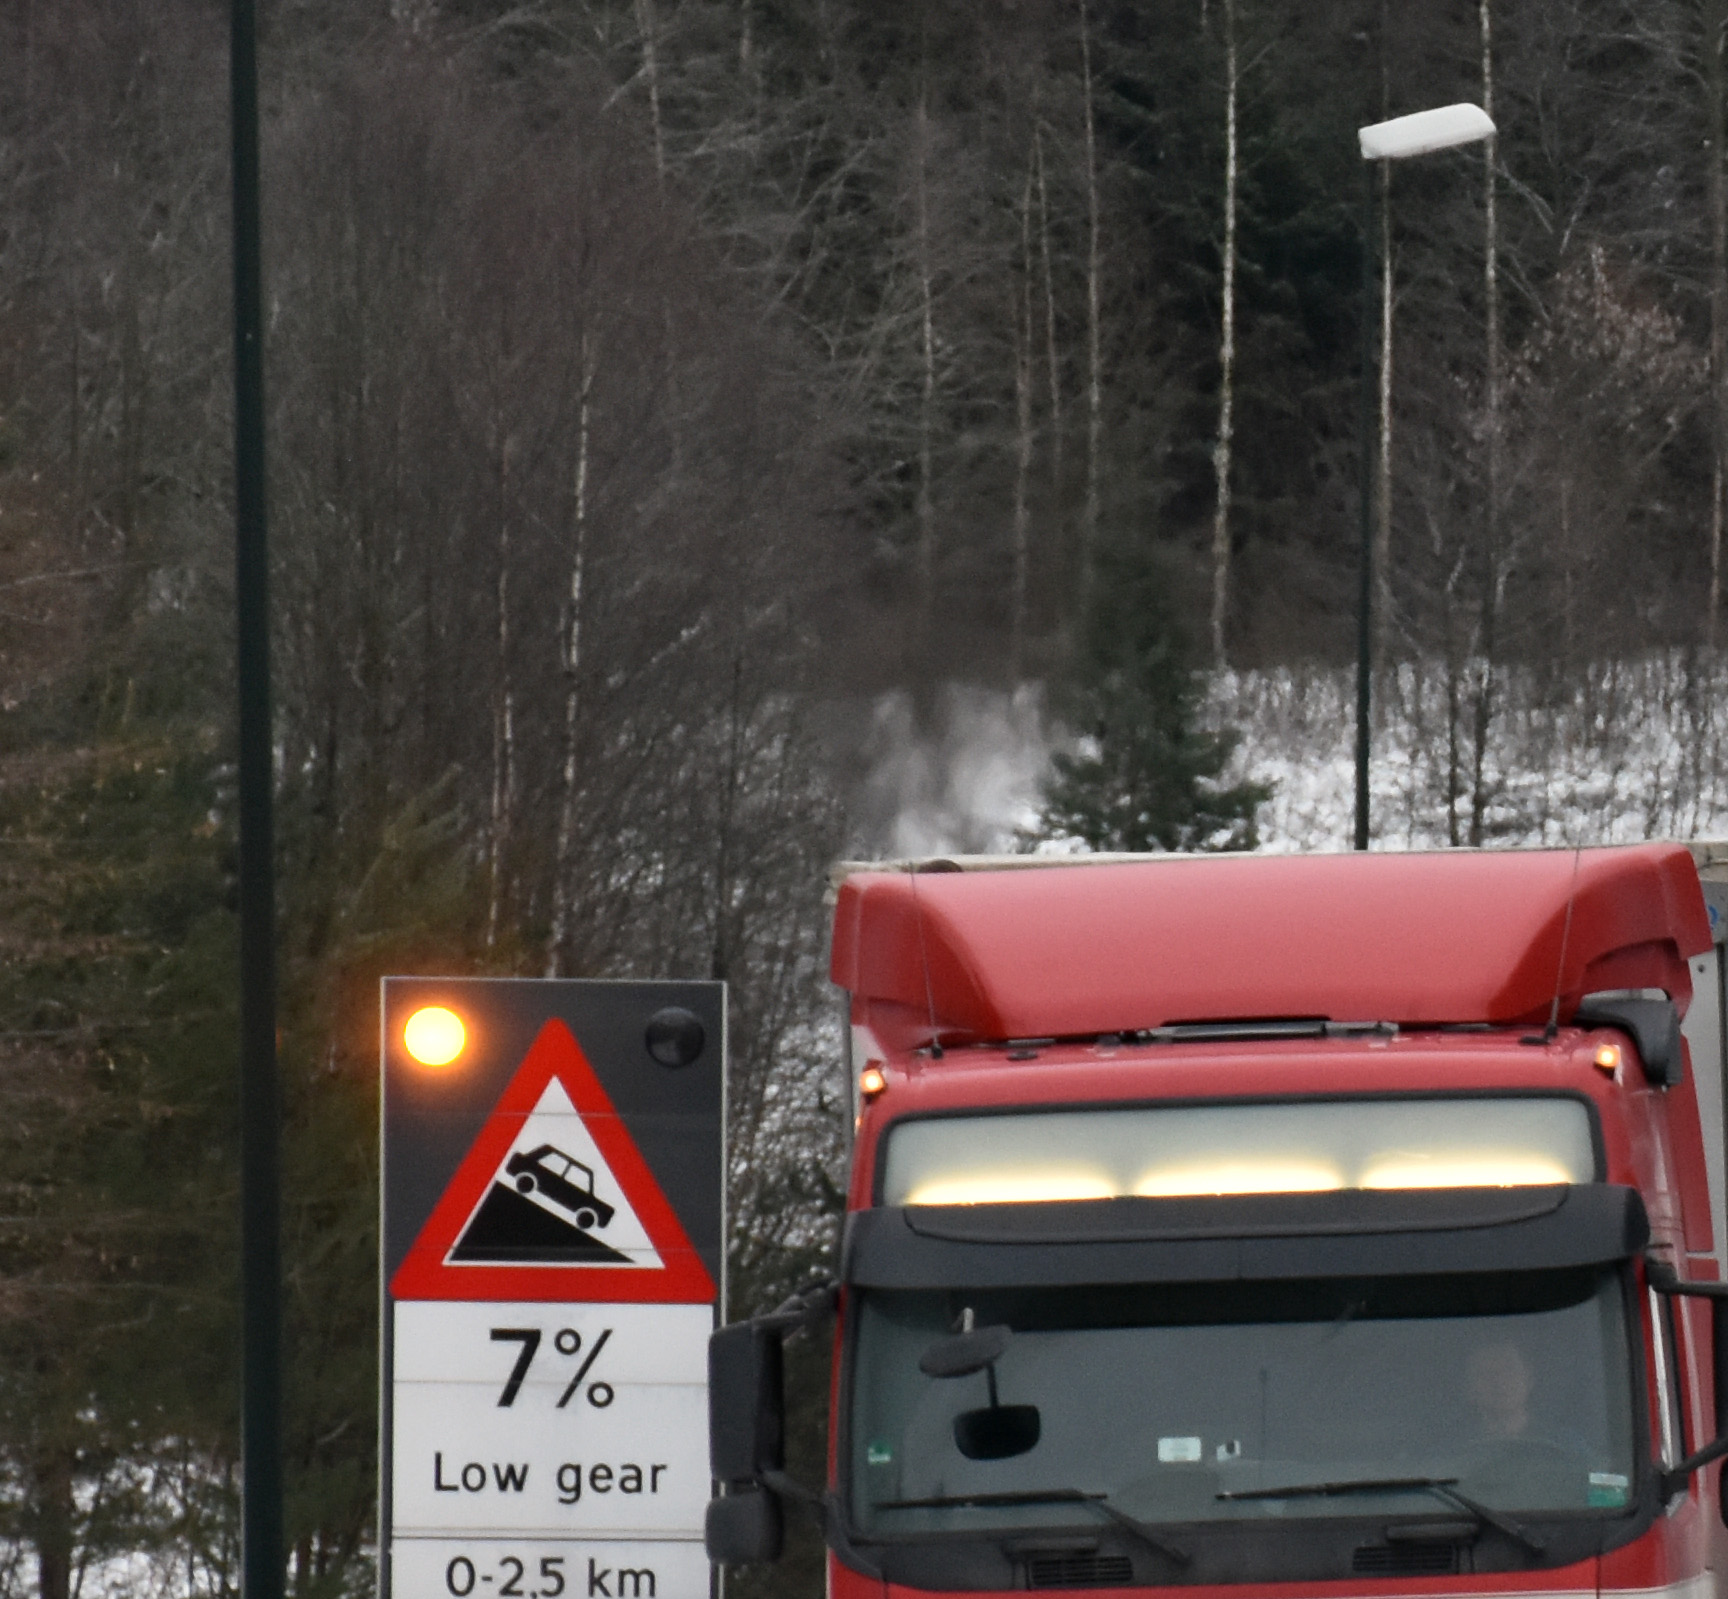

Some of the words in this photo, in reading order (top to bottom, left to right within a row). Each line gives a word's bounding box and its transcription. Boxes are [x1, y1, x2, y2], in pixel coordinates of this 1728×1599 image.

[489, 1327, 615, 1409] 7%
[434, 1451, 530, 1493] Low
[556, 1462, 669, 1505] gear
[588, 1557, 657, 1598] km
